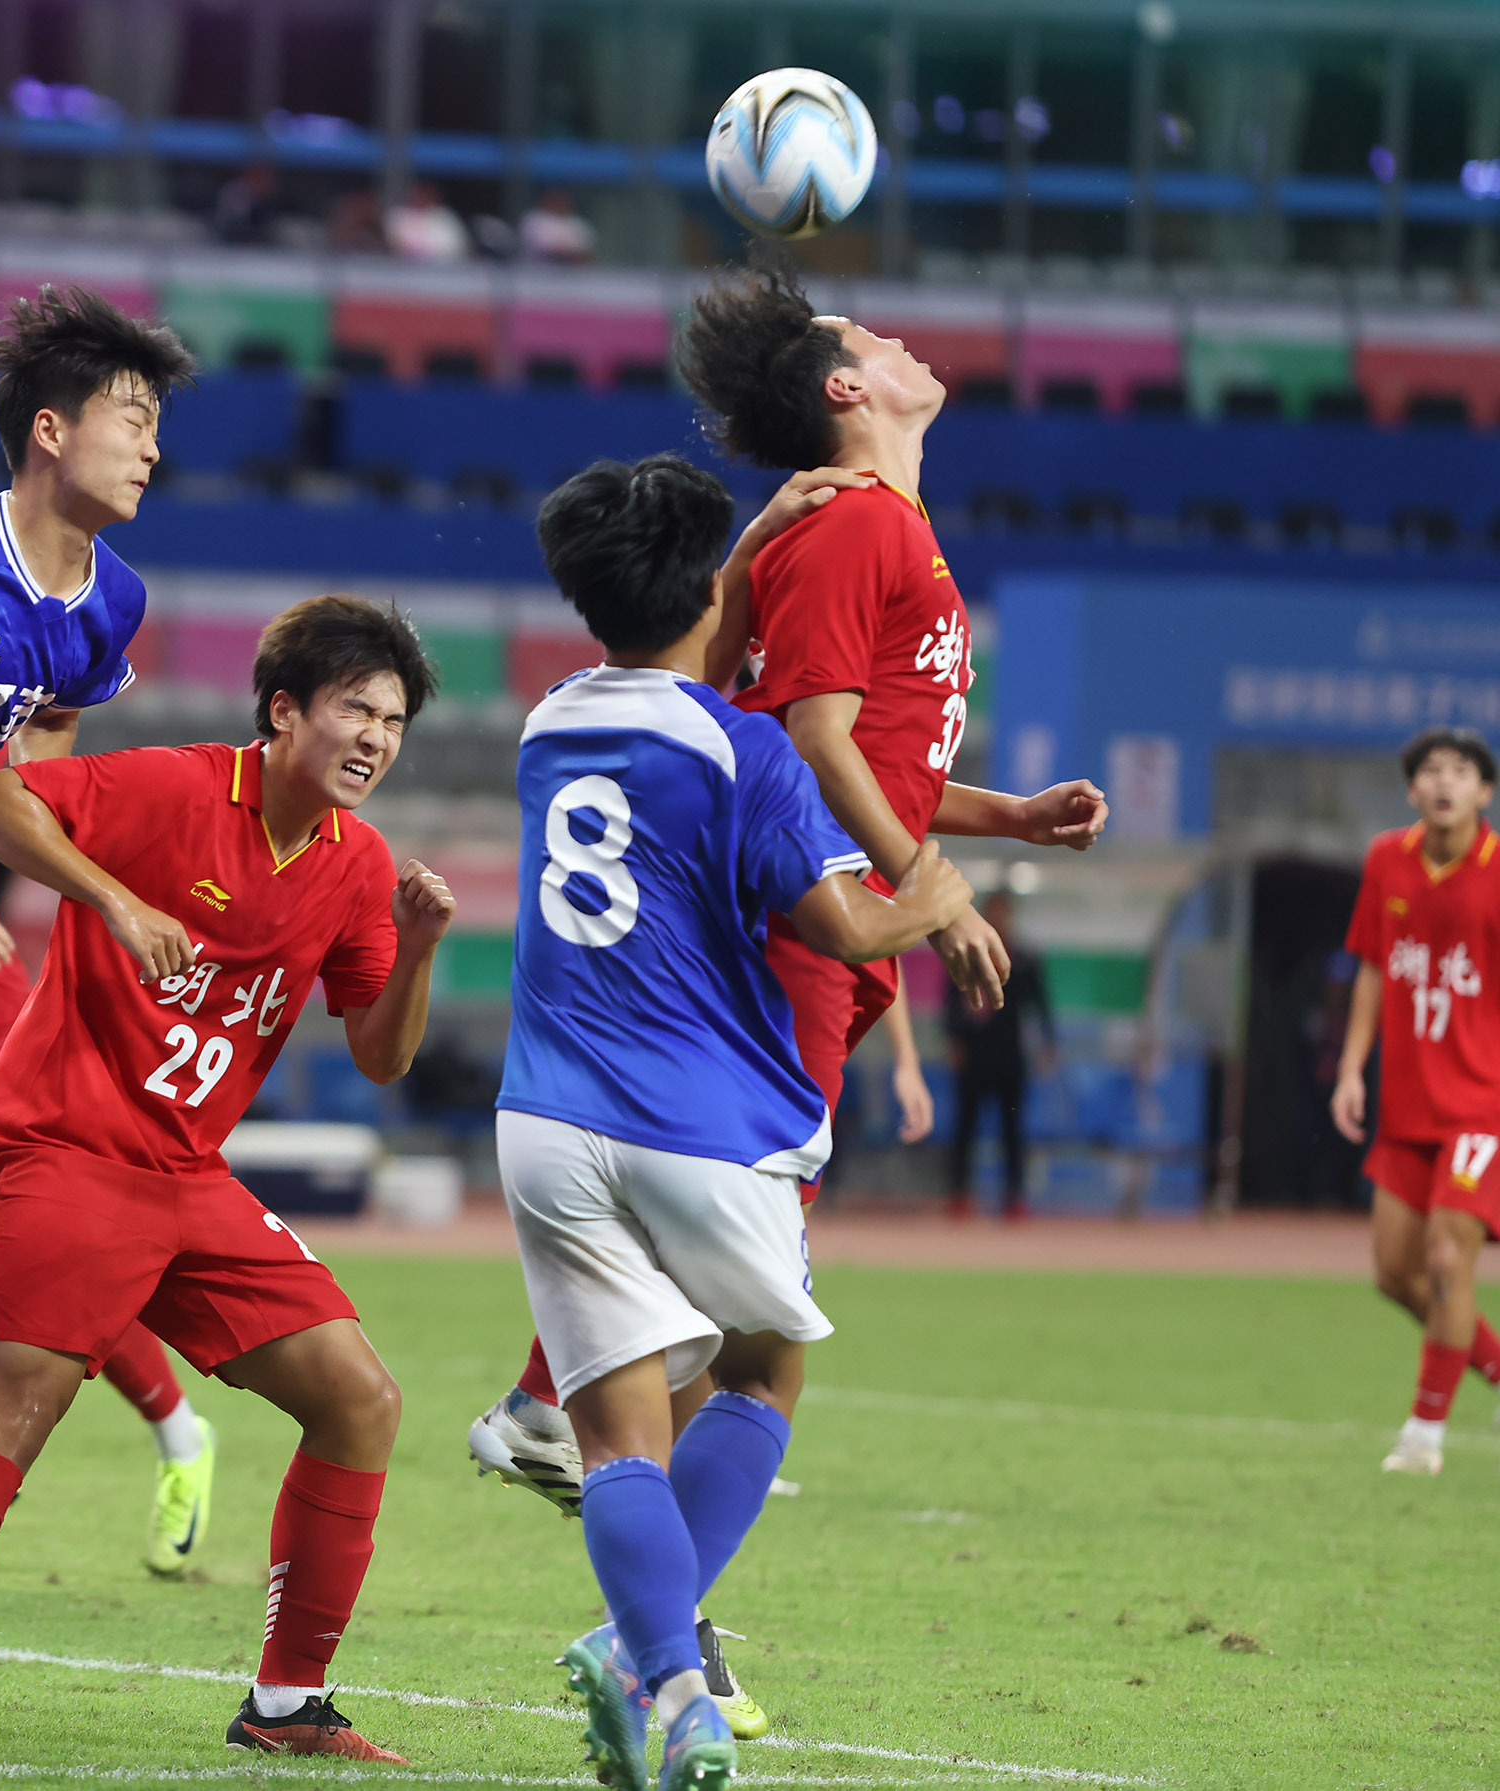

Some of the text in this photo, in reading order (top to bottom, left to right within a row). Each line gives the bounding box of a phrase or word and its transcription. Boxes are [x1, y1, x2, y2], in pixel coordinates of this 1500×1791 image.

[915, 610, 976, 690] 湖
[539, 774, 639, 948] 8
[190, 887, 227, 912] LI-NING
[1412, 985, 1451, 1042] 17
[144, 1024, 234, 1108] 29
[1451, 1133, 1499, 1183] 17
